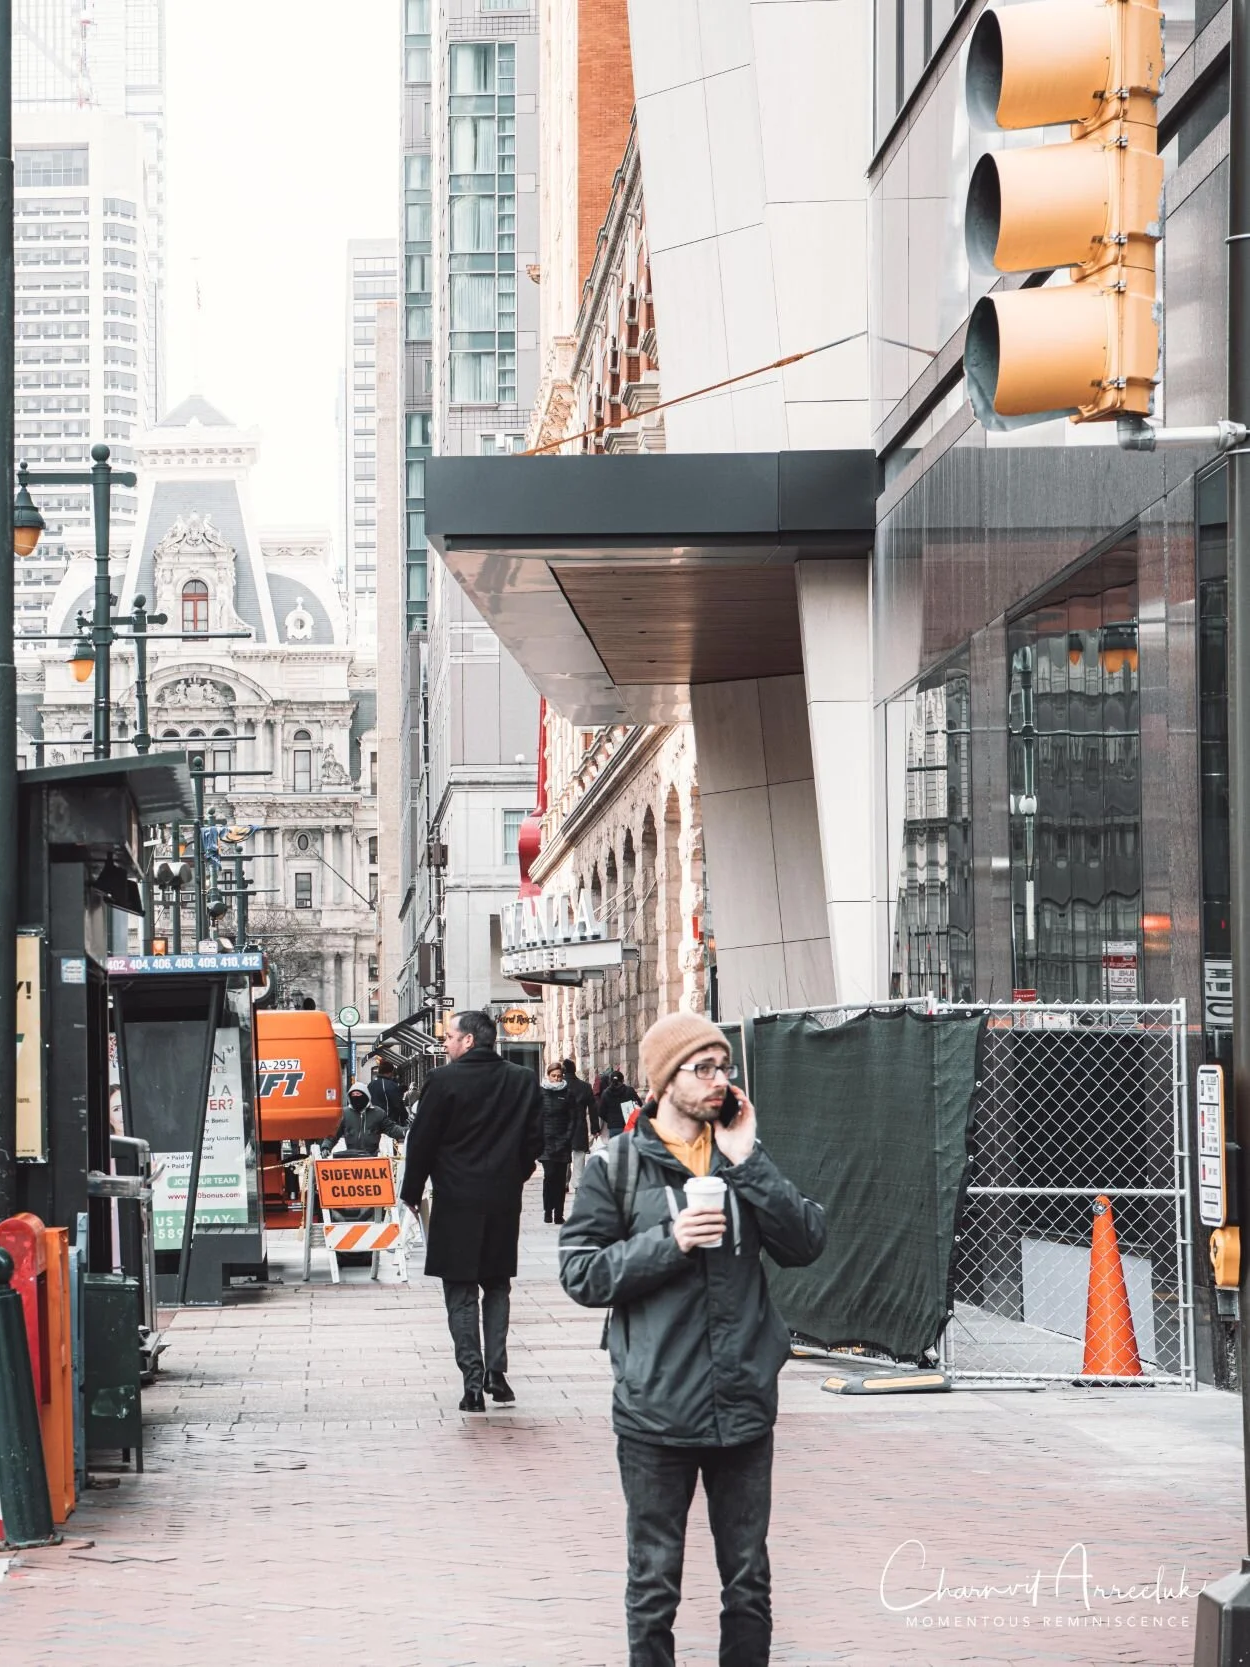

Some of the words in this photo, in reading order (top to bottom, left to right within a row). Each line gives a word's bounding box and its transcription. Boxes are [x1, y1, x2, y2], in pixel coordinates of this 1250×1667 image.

[129, 958, 150, 971] 404,
[152, 958, 173, 970] 406,
[175, 957, 196, 969] 408,
[197, 956, 218, 969] 409,
[220, 956, 239, 968] 410,
[241, 955, 260, 967] 412
[213, 1176, 236, 1185] TEAM
[321, 1167, 389, 1181] SIDEWALK
[331, 1185, 382, 1198] CLOSED
[155, 1216, 174, 1228] US
